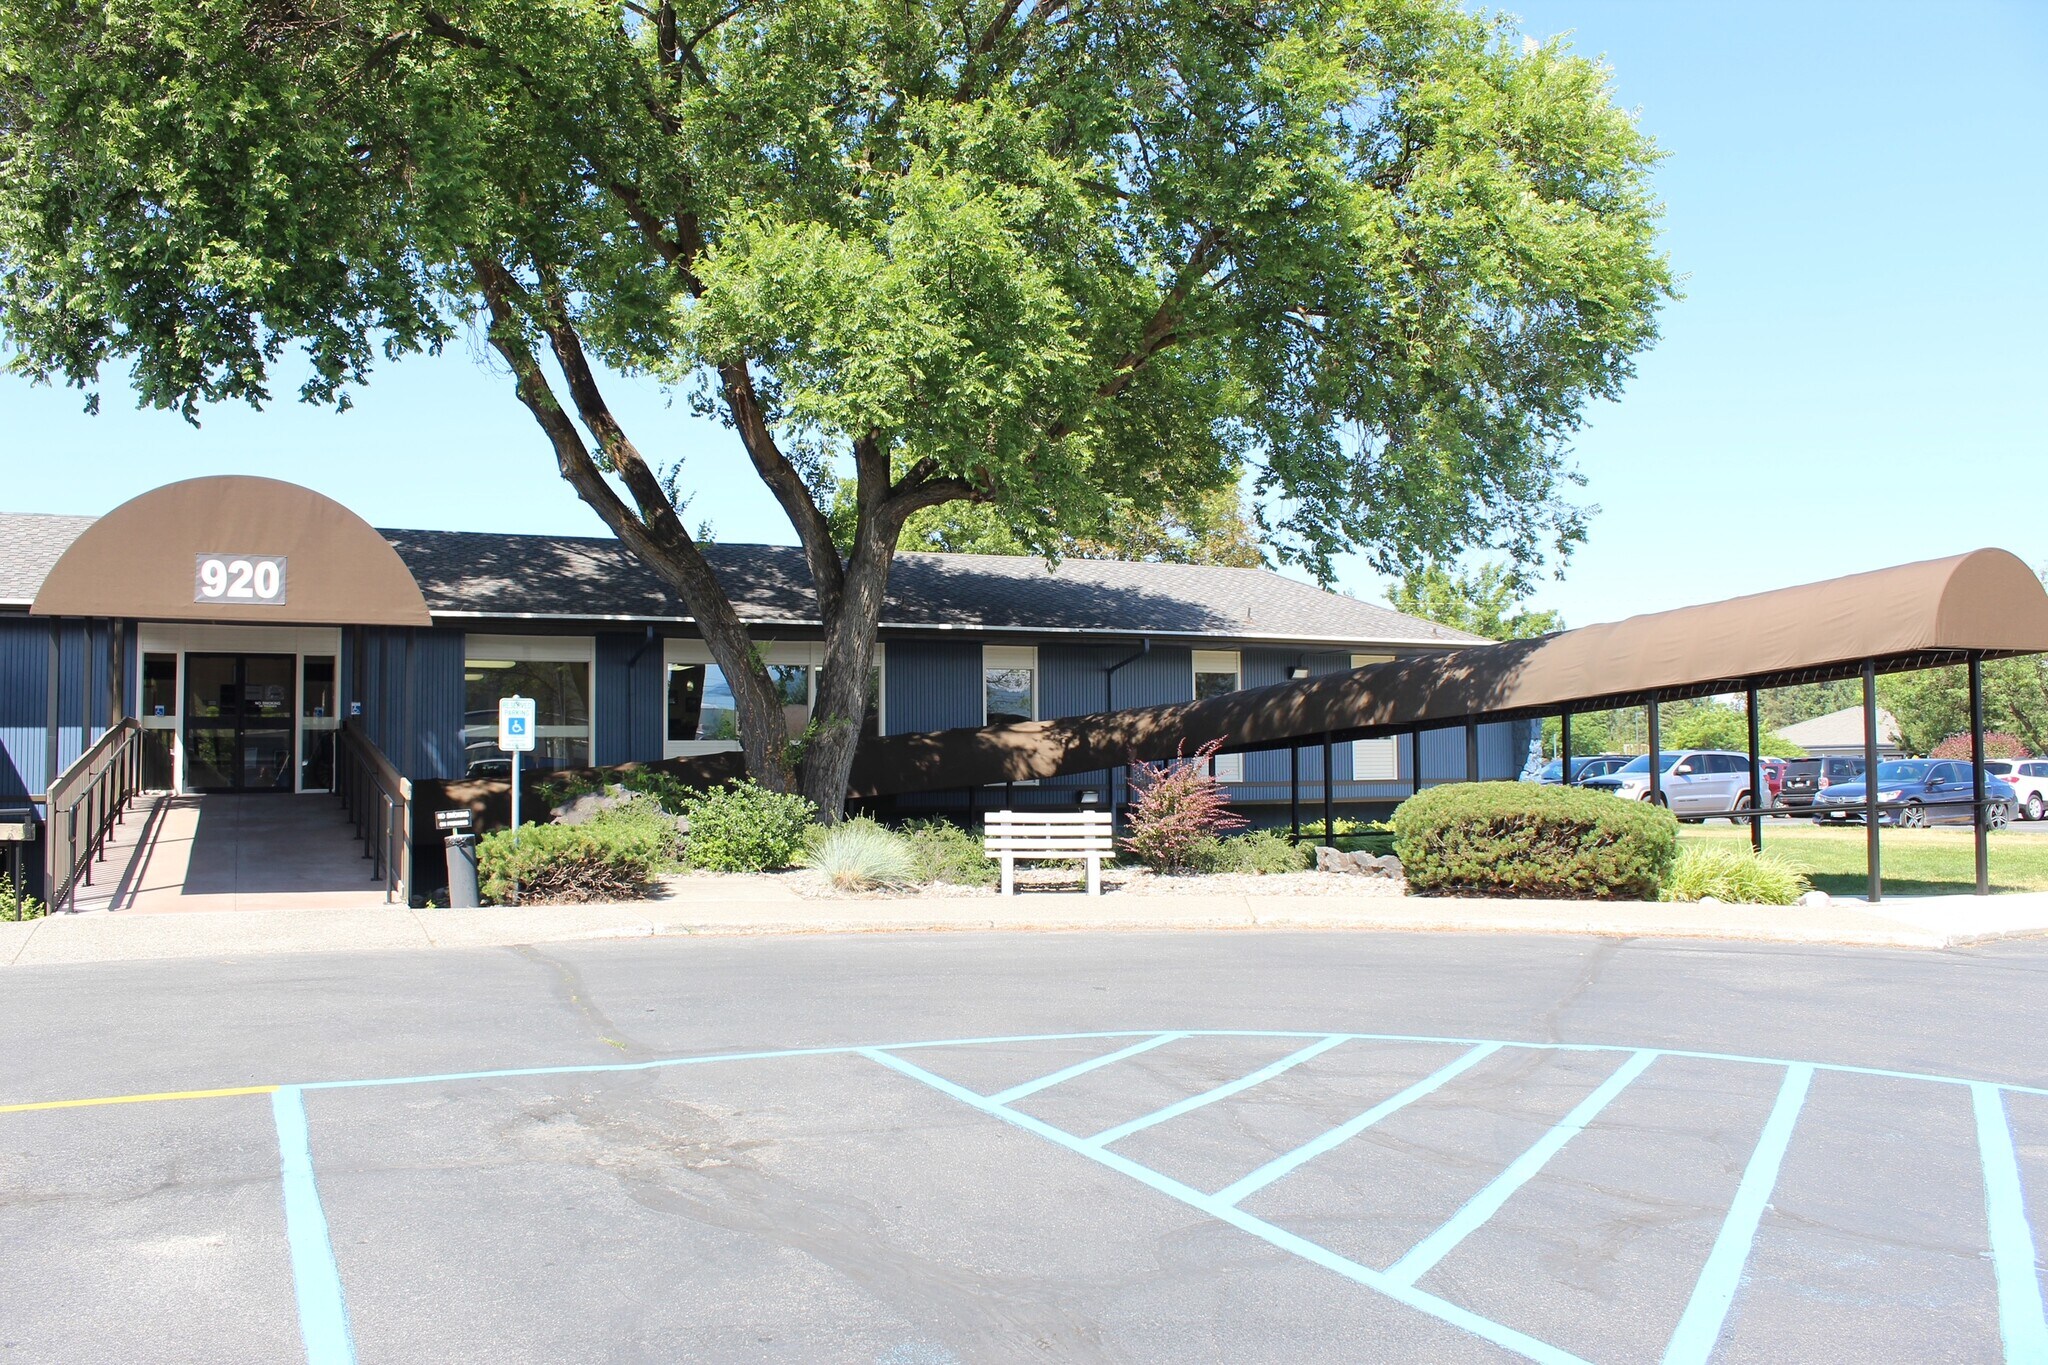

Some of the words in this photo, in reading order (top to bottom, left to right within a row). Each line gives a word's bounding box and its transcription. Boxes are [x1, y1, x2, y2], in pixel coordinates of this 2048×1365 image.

[201, 559, 280, 599] 920
[502, 701, 532, 709] RESERVED
[437, 812, 446, 820] NO
